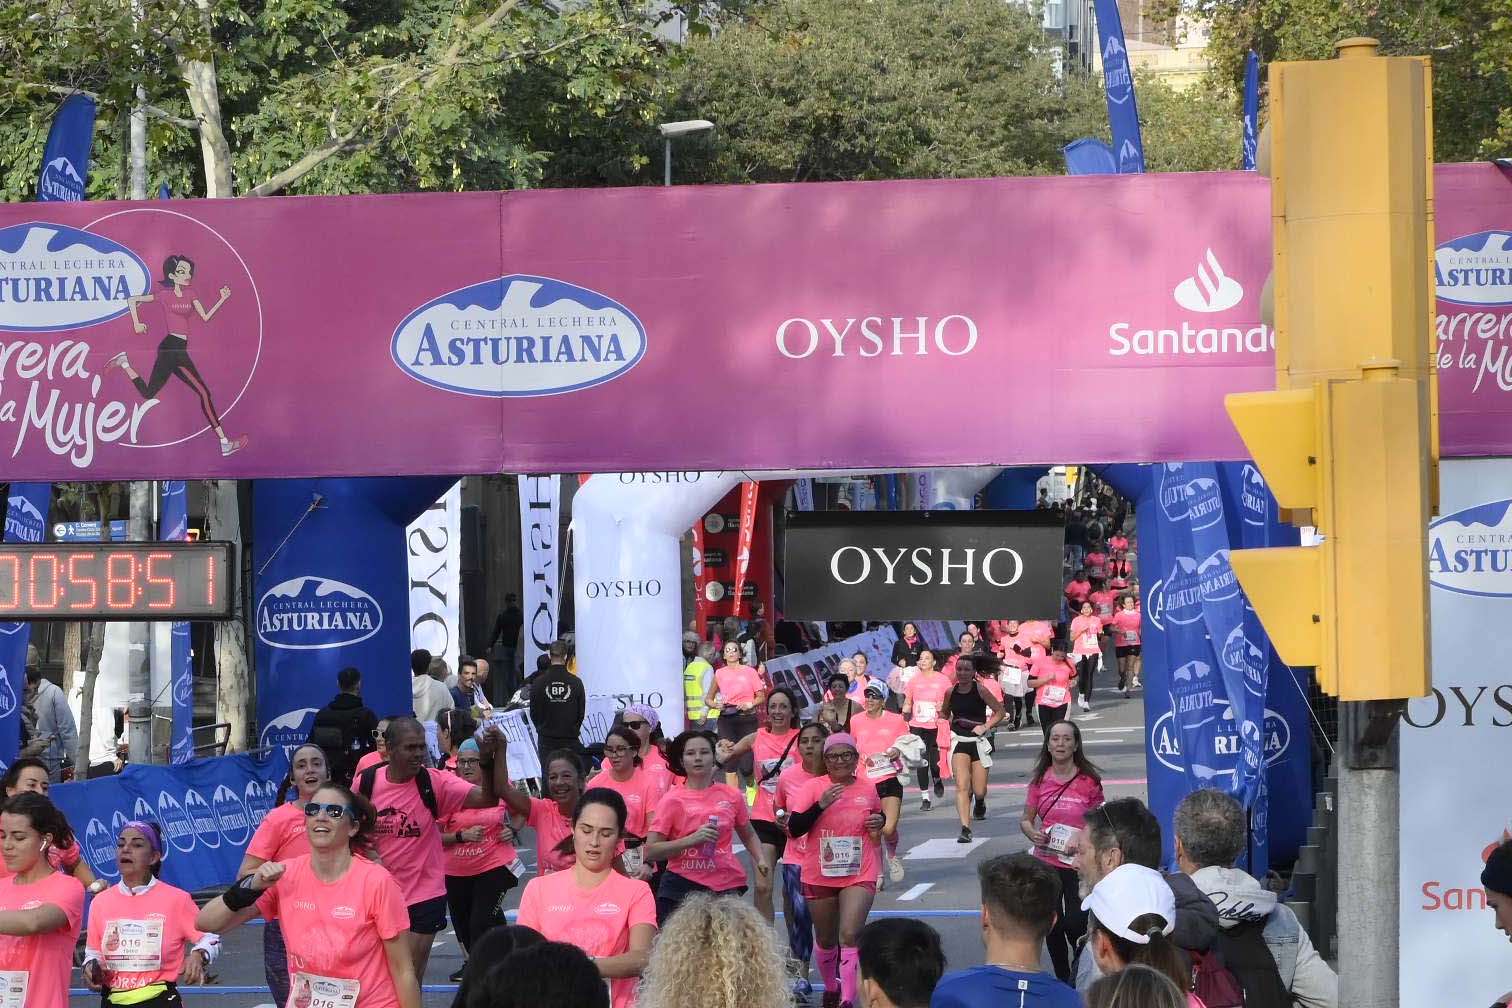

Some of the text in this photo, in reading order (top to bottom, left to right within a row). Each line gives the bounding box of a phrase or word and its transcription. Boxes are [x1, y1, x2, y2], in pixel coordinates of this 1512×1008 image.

[54, 259, 126, 270] LECHERA
[1449, 256, 1501, 265] CENTRAL
[450, 315, 618, 330] CENTRAL LECHERA
[411, 321, 627, 367] ASTURIANA
[775, 314, 979, 358] OYSHO
[1458, 341, 1477, 369] la
[12, 373, 161, 469] Mujer
[829, 545, 1024, 588] OYSHO
[586, 579, 662, 599] OYSHO
[273, 600, 369, 611] CENTRAL LECHERA
[259, 605, 374, 633] ASTURIANA
[551, 686, 565, 696] BP
[312, 998, 334, 1008] 016
